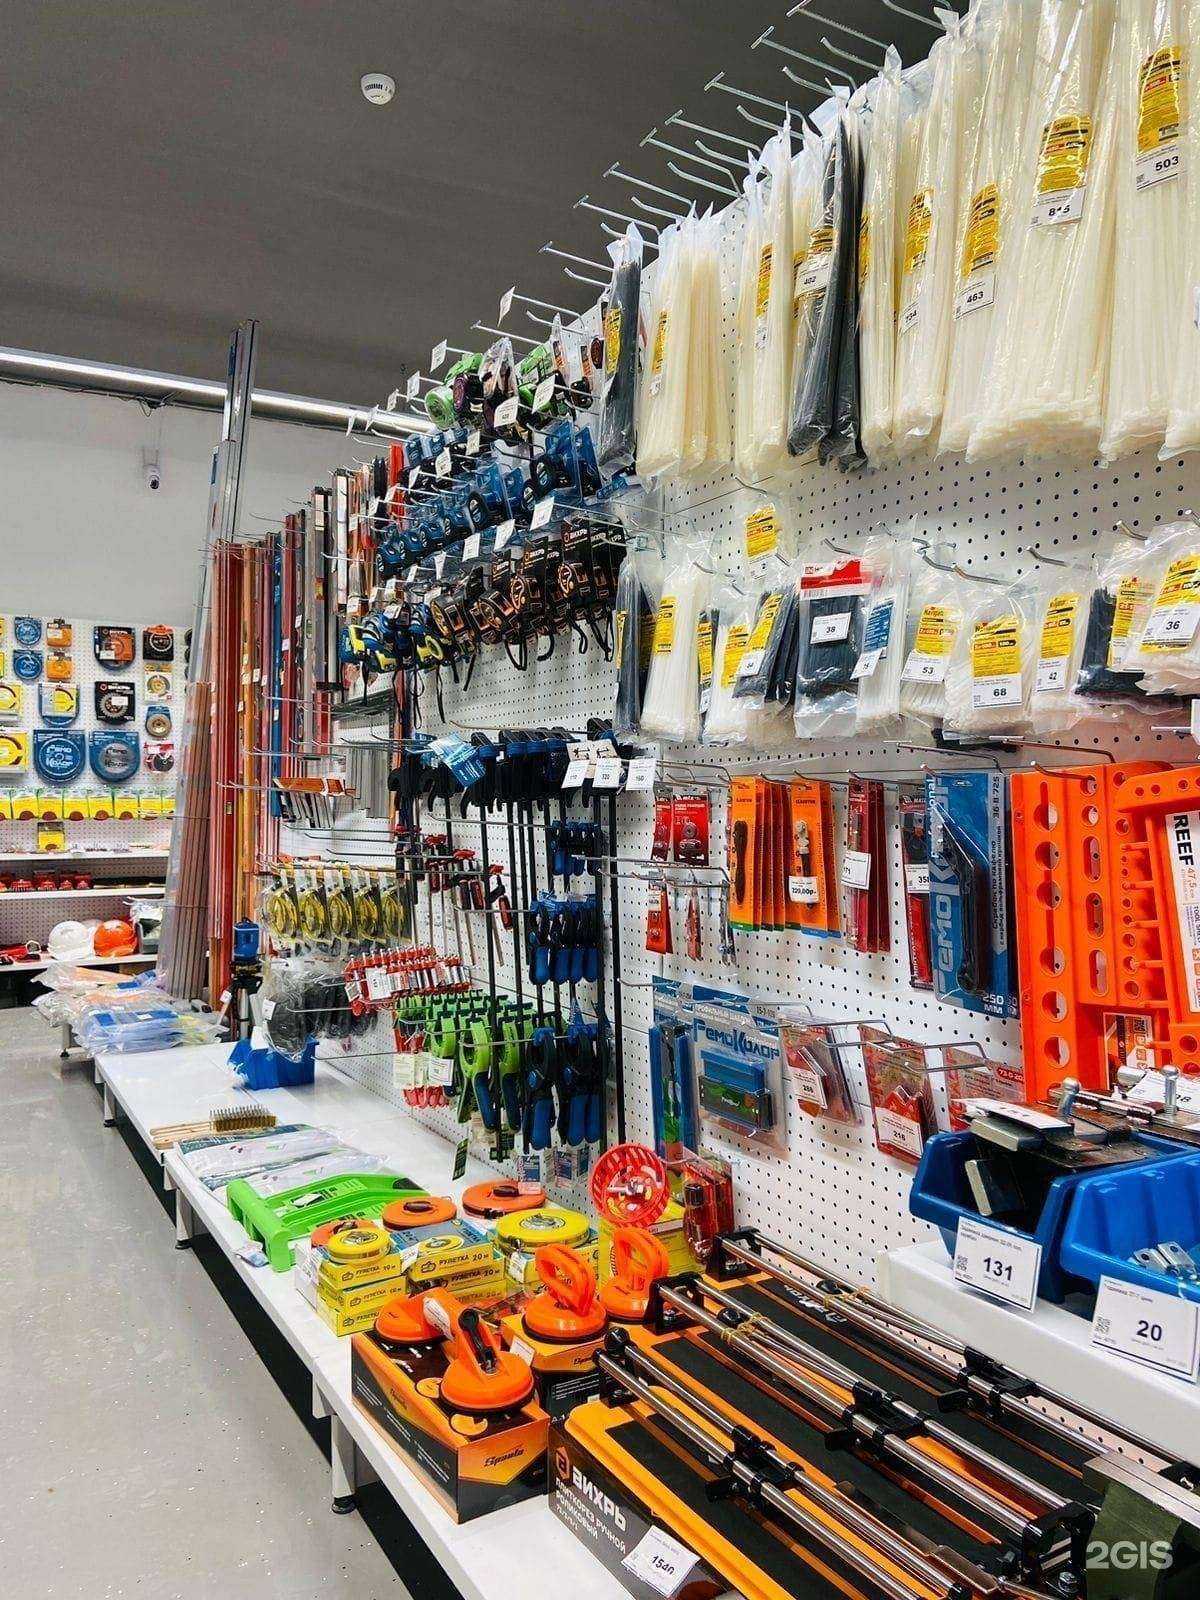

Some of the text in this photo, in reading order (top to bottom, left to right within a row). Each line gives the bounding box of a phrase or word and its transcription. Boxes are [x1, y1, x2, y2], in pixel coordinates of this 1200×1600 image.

[1155, 156, 1179, 172] 503
[1165, 620, 1181, 631] 36
[922, 667, 934, 675] 53
[993, 688, 1007, 697] 68
[1174, 814, 1195, 866] REEF
[984, 1257, 1013, 1281] 131
[1136, 1320, 1163, 1342] 20
[572, 1465, 627, 1532] ВИХРЬ
[652, 1554, 675, 1575] 1540
